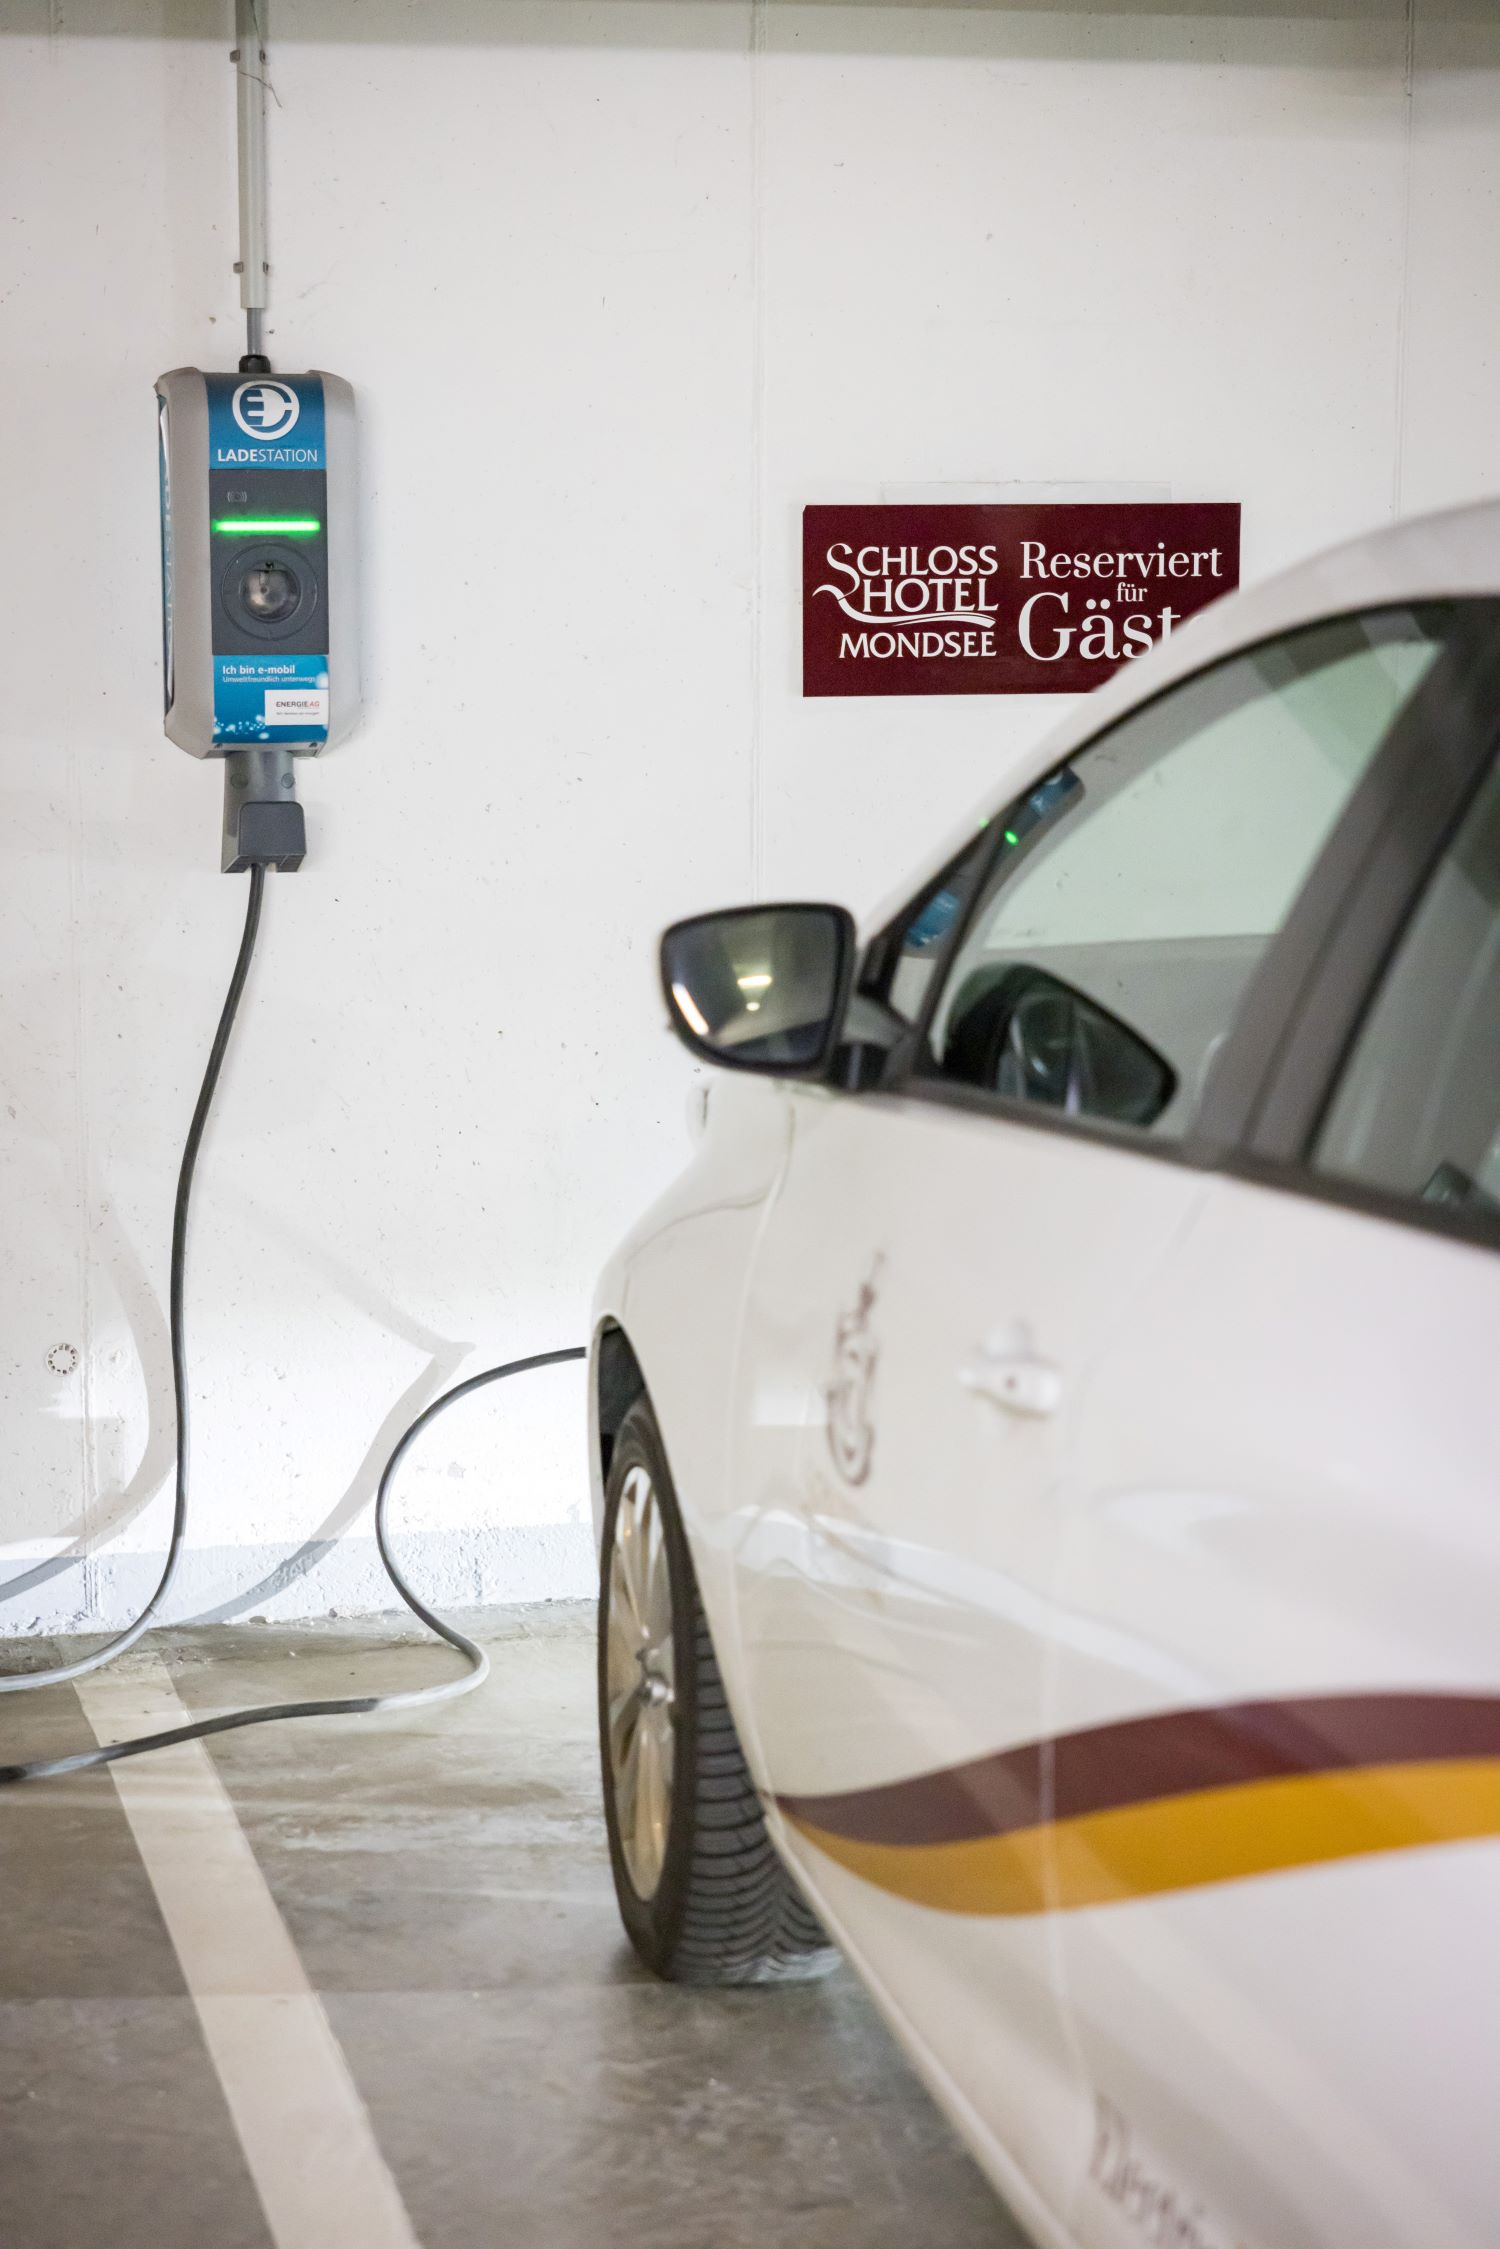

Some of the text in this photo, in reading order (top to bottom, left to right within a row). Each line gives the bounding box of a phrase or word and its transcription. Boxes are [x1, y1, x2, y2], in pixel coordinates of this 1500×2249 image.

[217, 448, 318, 463] LADESTATION
[825, 543, 999, 597] SCHLOSS
[1019, 541, 1223, 579] Reserviert
[862, 577, 999, 613] HOTEL
[1116, 582, 1148, 603] für
[1018, 591, 1188, 661] Gäst
[838, 631, 998, 659] MONDSEE
[222, 664, 296, 675] Ich bin e-mobil
